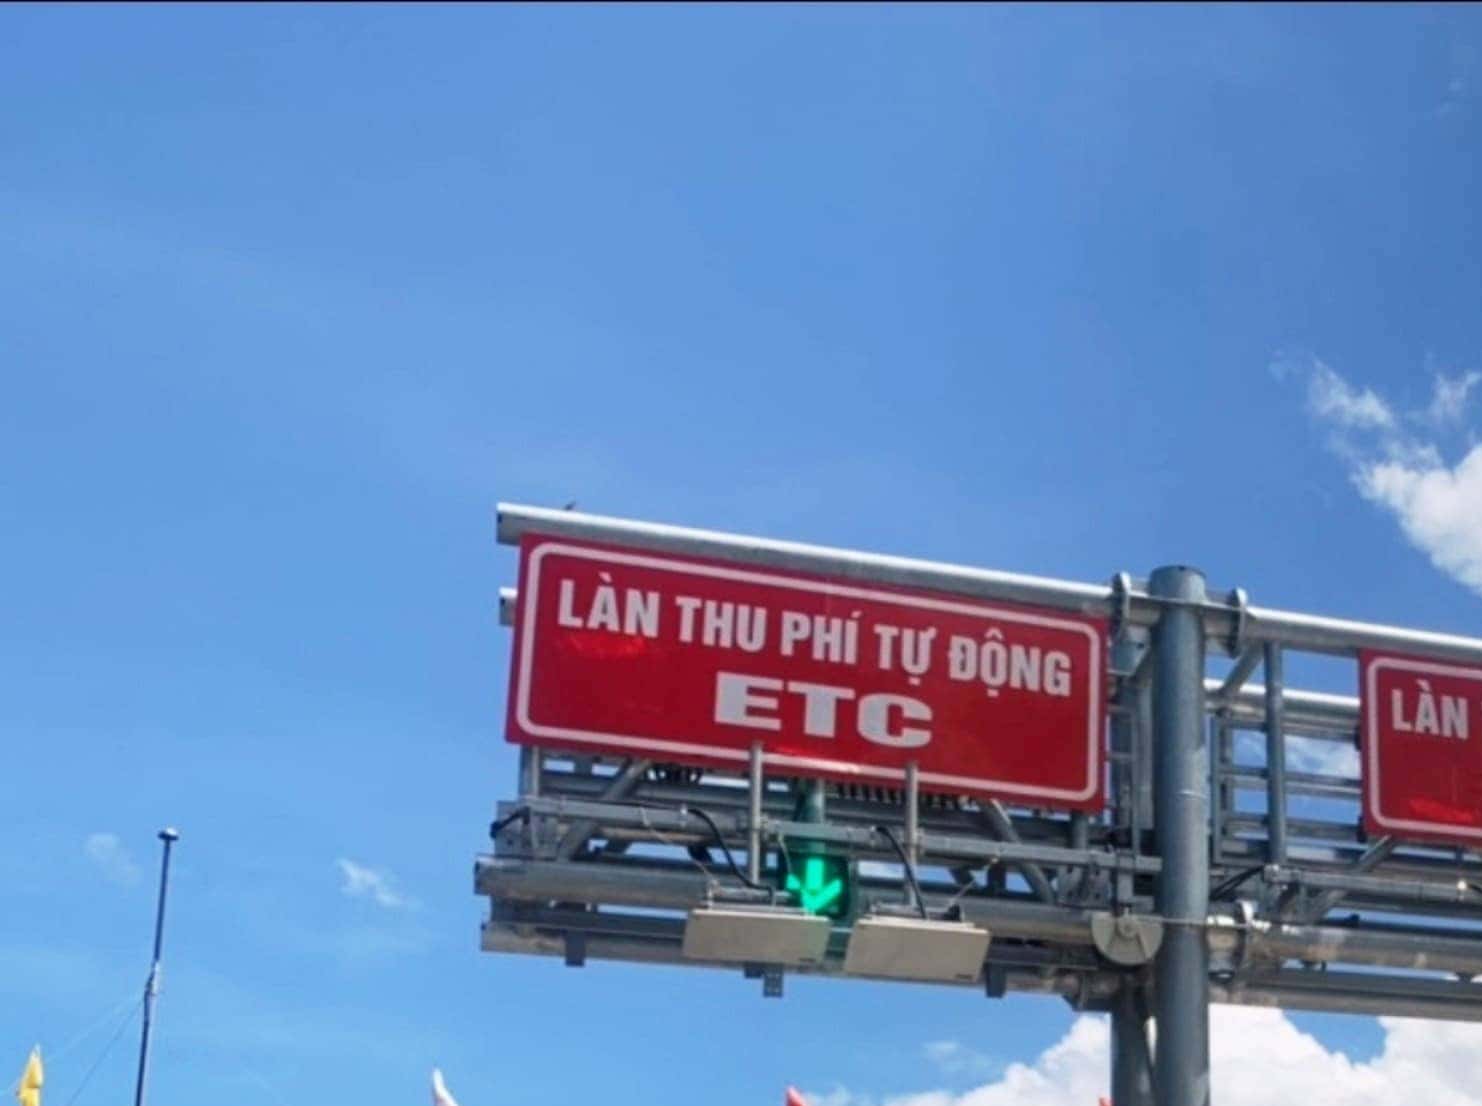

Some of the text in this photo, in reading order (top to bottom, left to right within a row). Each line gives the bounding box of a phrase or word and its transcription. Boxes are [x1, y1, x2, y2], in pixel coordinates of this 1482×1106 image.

[557, 572, 1072, 697] LÀN THU PHÍ TỰ ĐỘNG
[714, 671, 933, 748] ETC
[1391, 679, 1469, 739] LÀN
